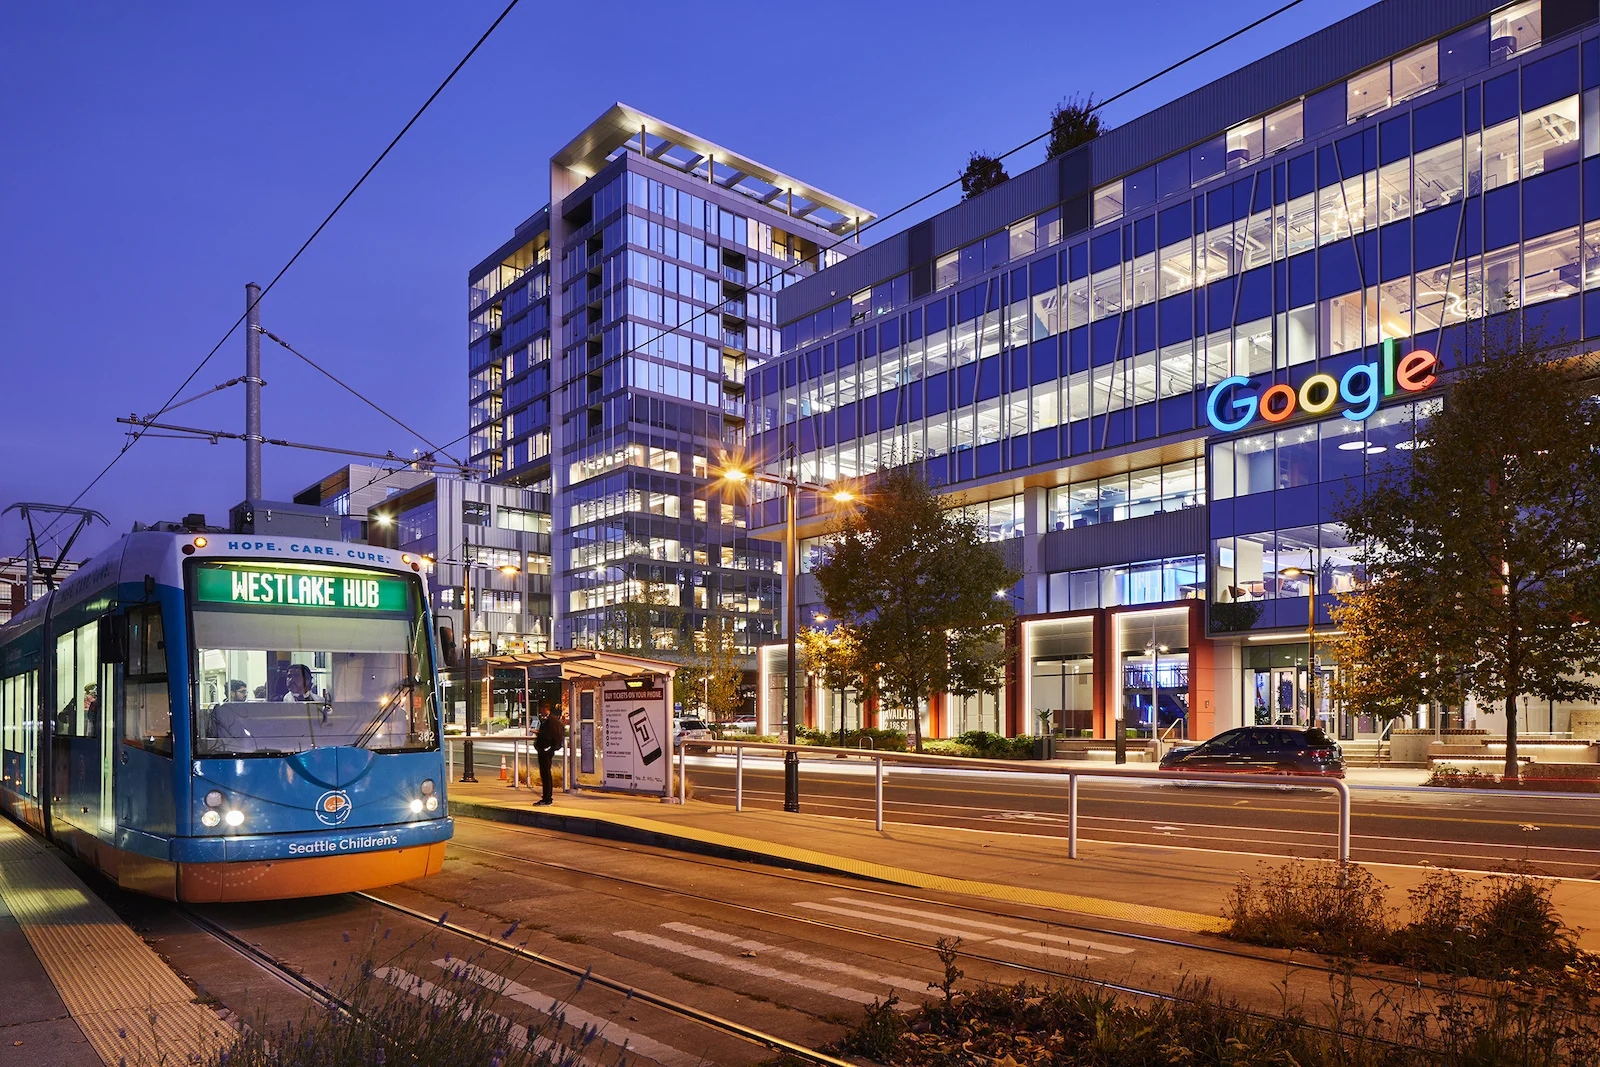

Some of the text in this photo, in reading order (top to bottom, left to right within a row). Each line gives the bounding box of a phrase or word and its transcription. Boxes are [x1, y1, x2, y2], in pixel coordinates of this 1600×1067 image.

[1206, 336, 1438, 432] Google
[228, 541, 390, 564] HOPE. CARE. CURE.
[231, 571, 379, 608] WESTLAKE HUB
[884, 708, 921, 720] AVAILABL
[418, 731, 435, 742] 302
[288, 835, 398, 855] Seattle Children's
